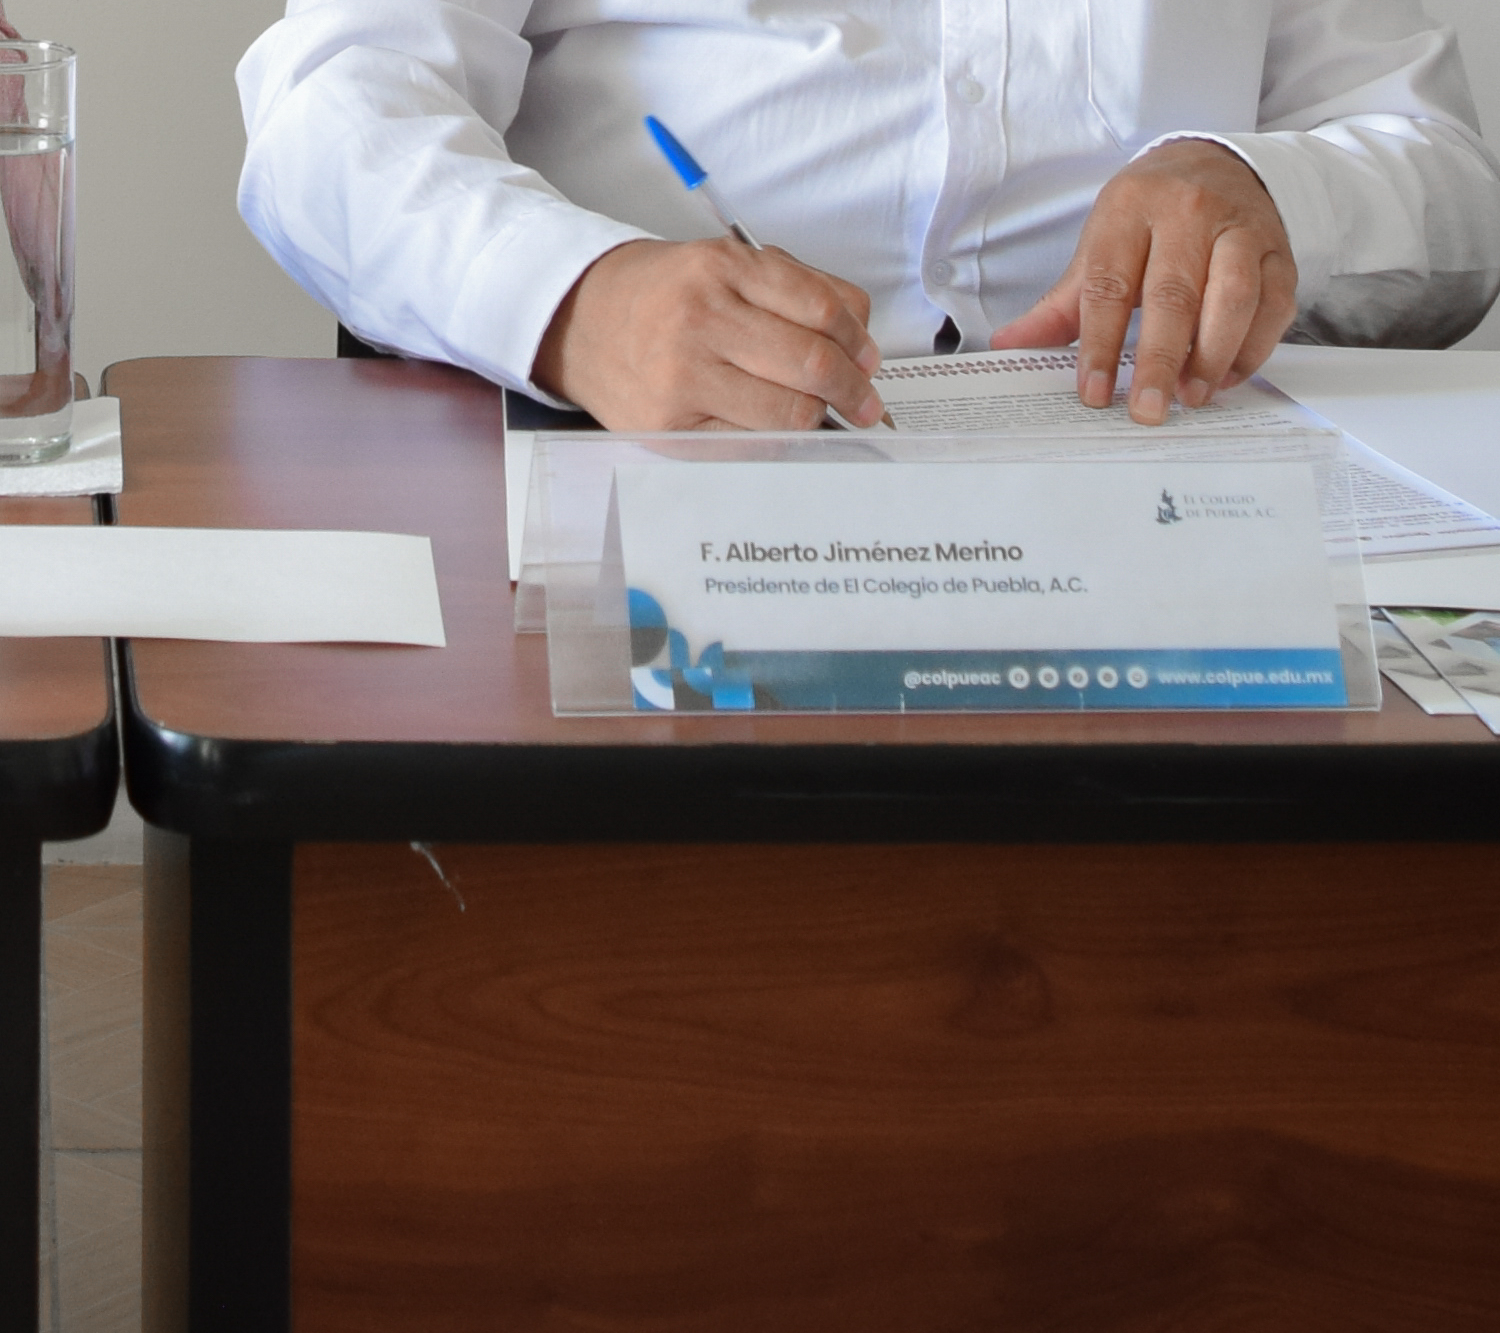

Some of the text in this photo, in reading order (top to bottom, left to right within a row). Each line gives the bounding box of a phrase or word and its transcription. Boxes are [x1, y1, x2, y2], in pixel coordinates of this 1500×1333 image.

[700, 540, 1024, 564] F. Alberto Jiménez Merino
[704, 576, 1090, 599] Presidente de El Colegio de Puebla, A.C.
